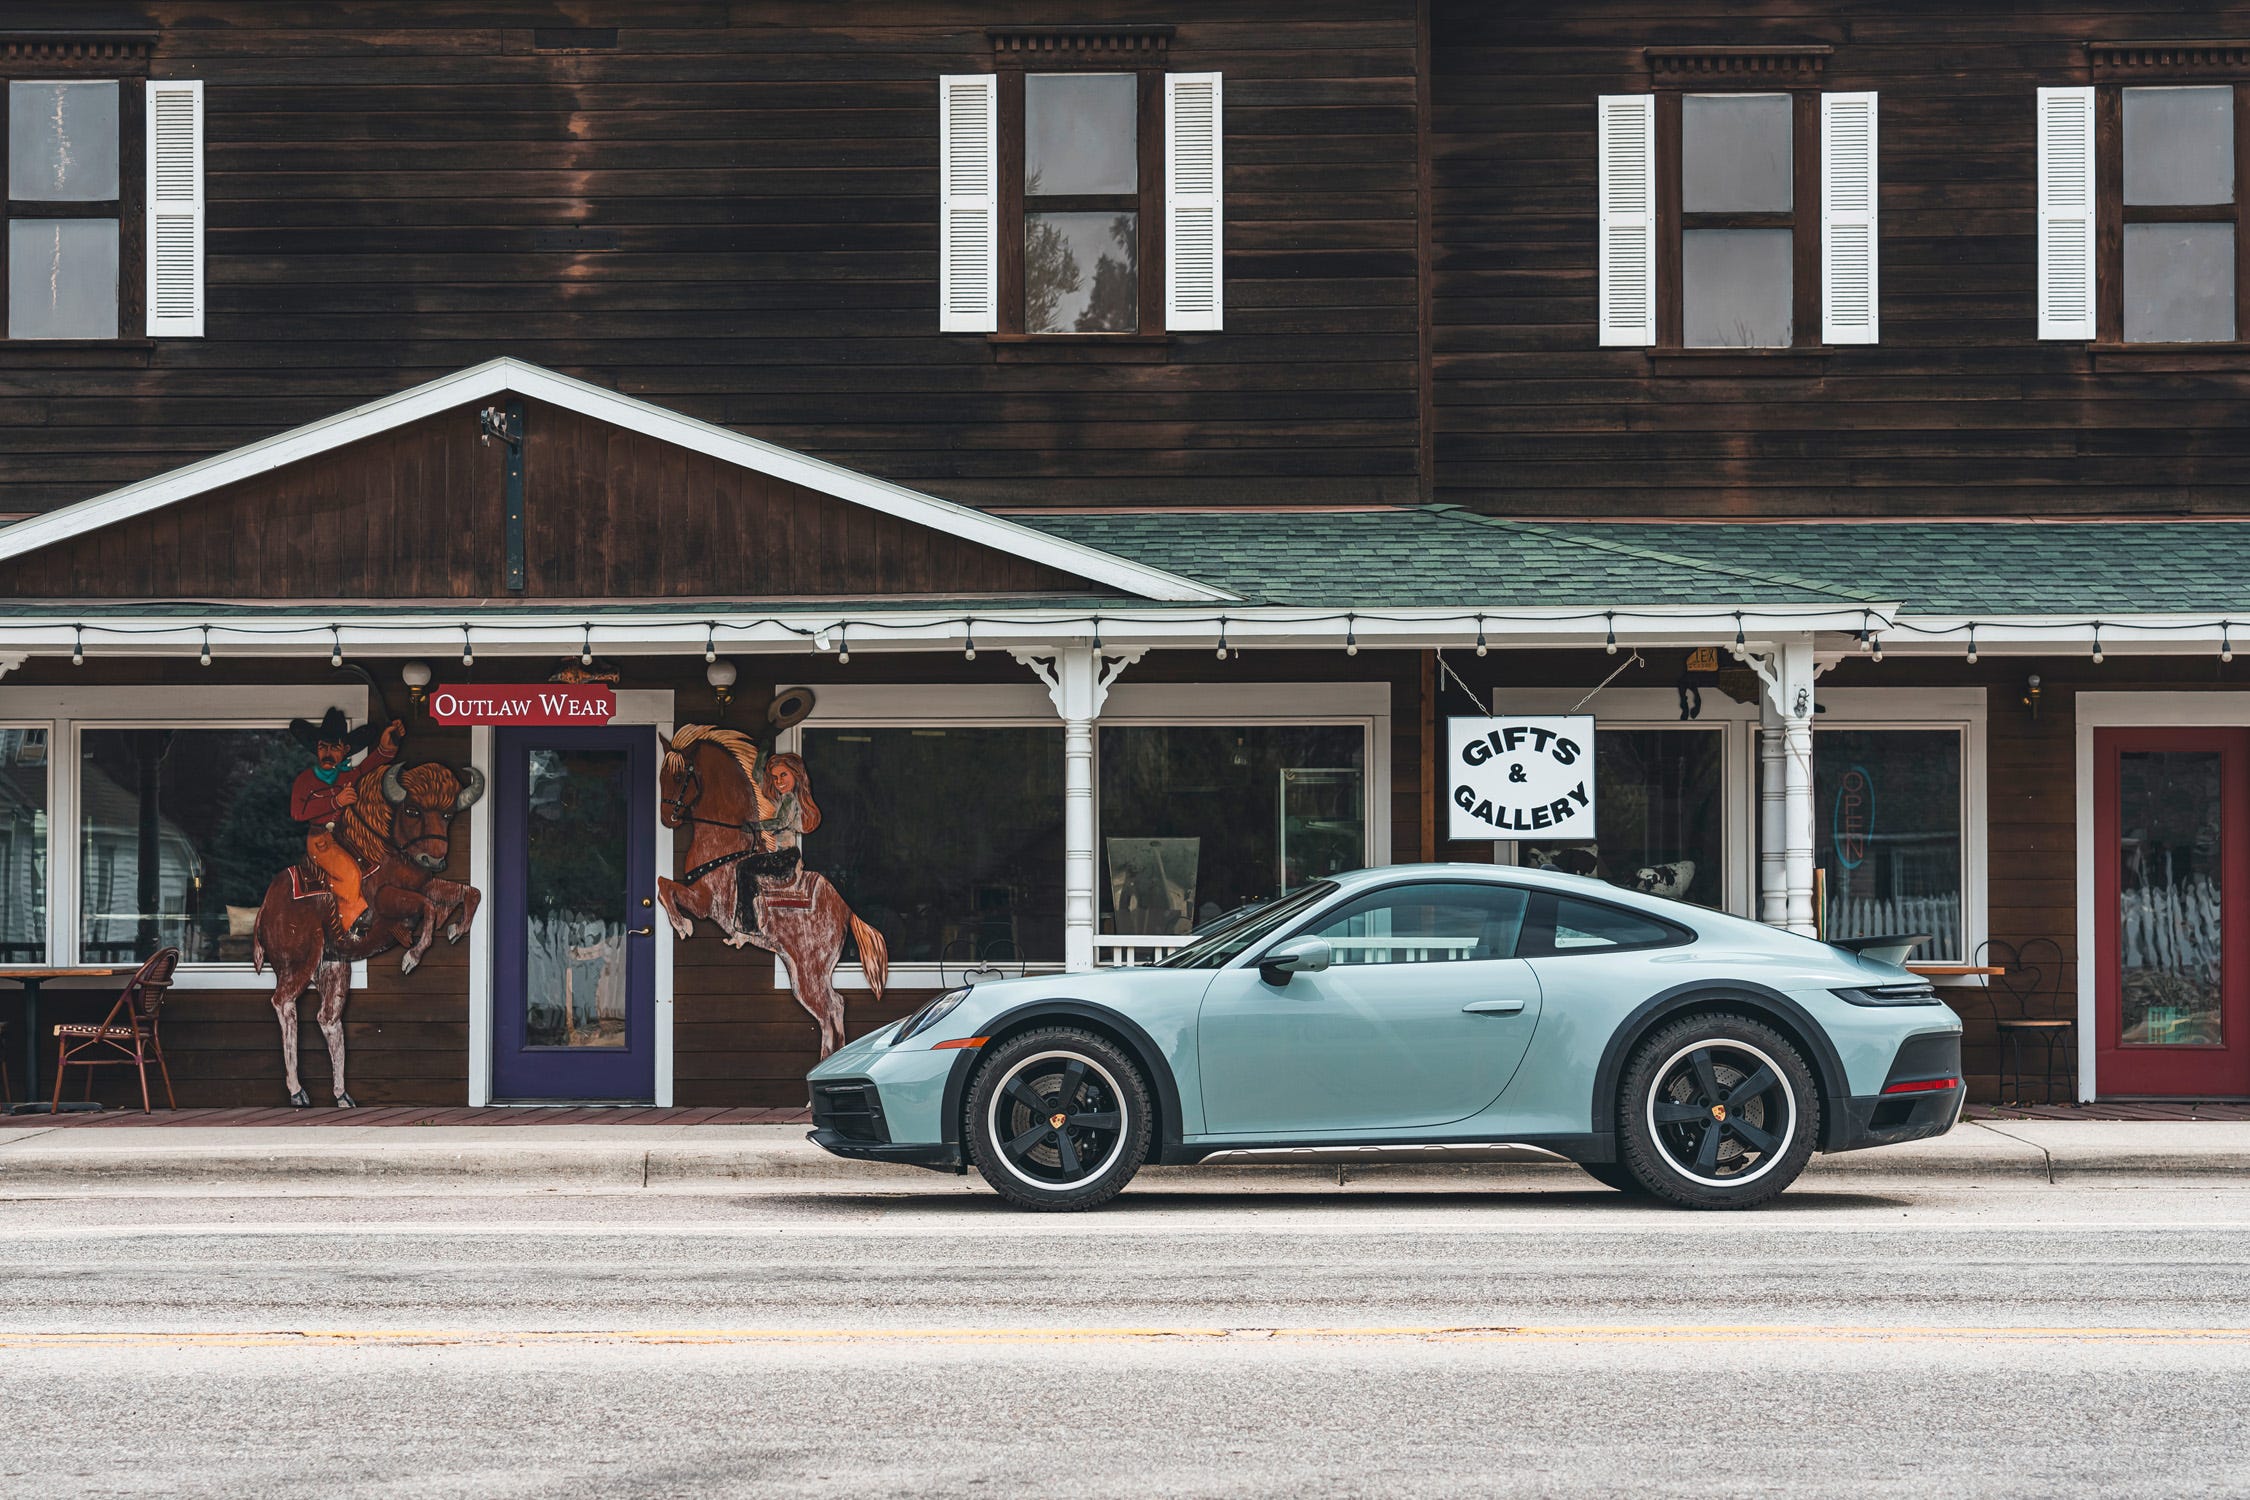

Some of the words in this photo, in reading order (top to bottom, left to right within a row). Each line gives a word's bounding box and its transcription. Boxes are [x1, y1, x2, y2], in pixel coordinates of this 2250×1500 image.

[435, 693, 532, 717] OUTLAW
[538, 693, 610, 717] WEAR
[1462, 726, 1581, 766] GIFTS
[1508, 763, 1528, 783] &
[1454, 780, 1590, 830] GALLERY
[1843, 772, 1864, 859] OPEN
